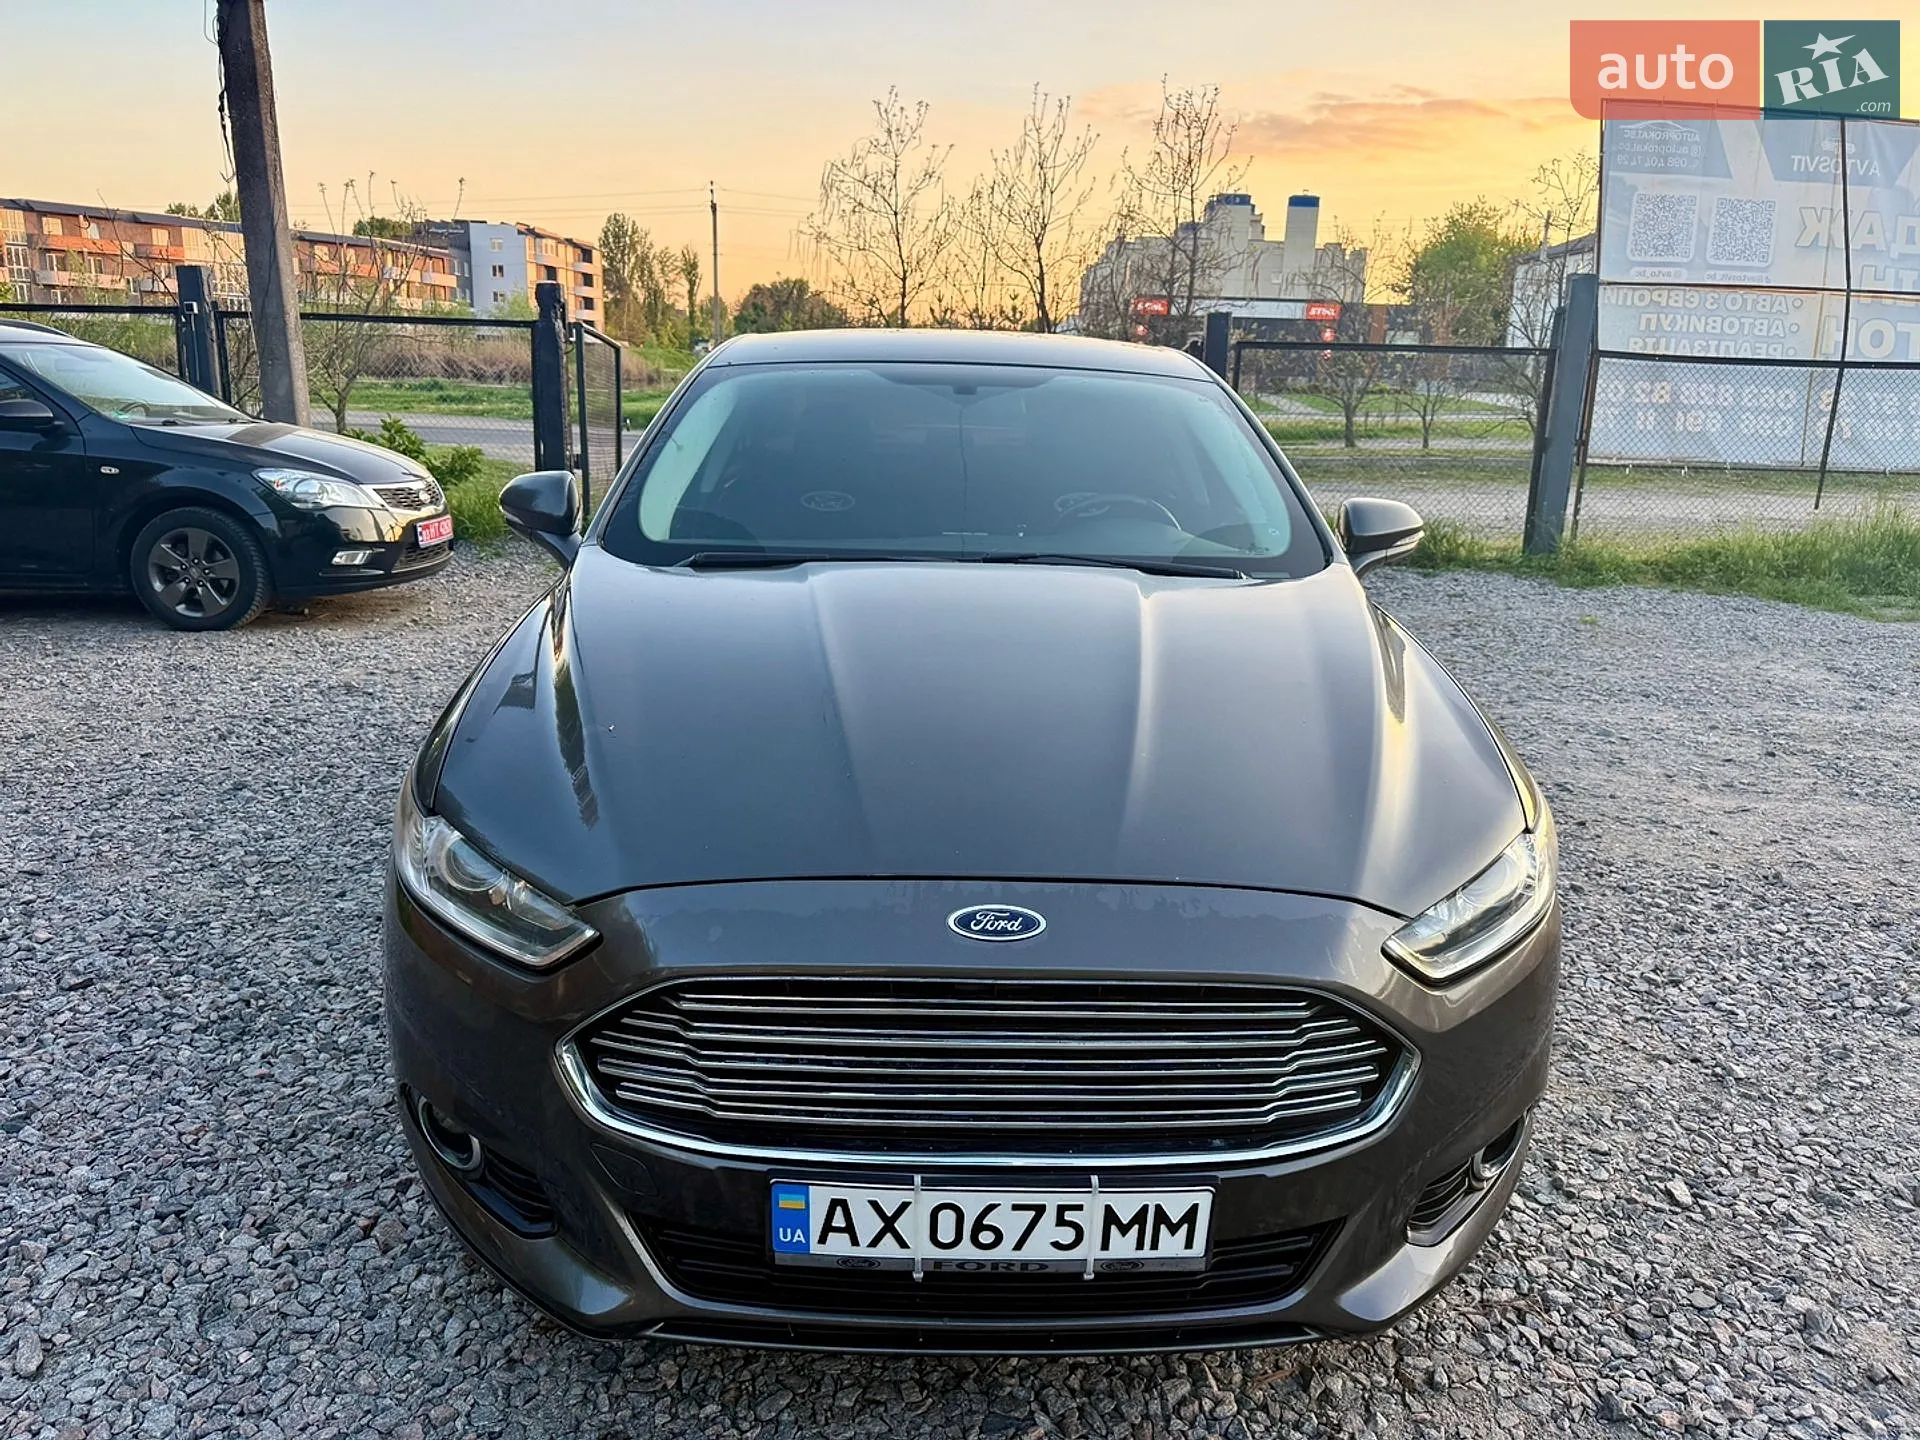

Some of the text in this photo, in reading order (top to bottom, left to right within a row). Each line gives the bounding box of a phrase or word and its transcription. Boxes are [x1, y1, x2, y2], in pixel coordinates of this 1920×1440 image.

[970, 910, 1023, 932] Ford
[816, 1197, 1201, 1252] AX 0675 MM
[778, 1227, 807, 1245] UA
[933, 1261, 1050, 1272] FORD
